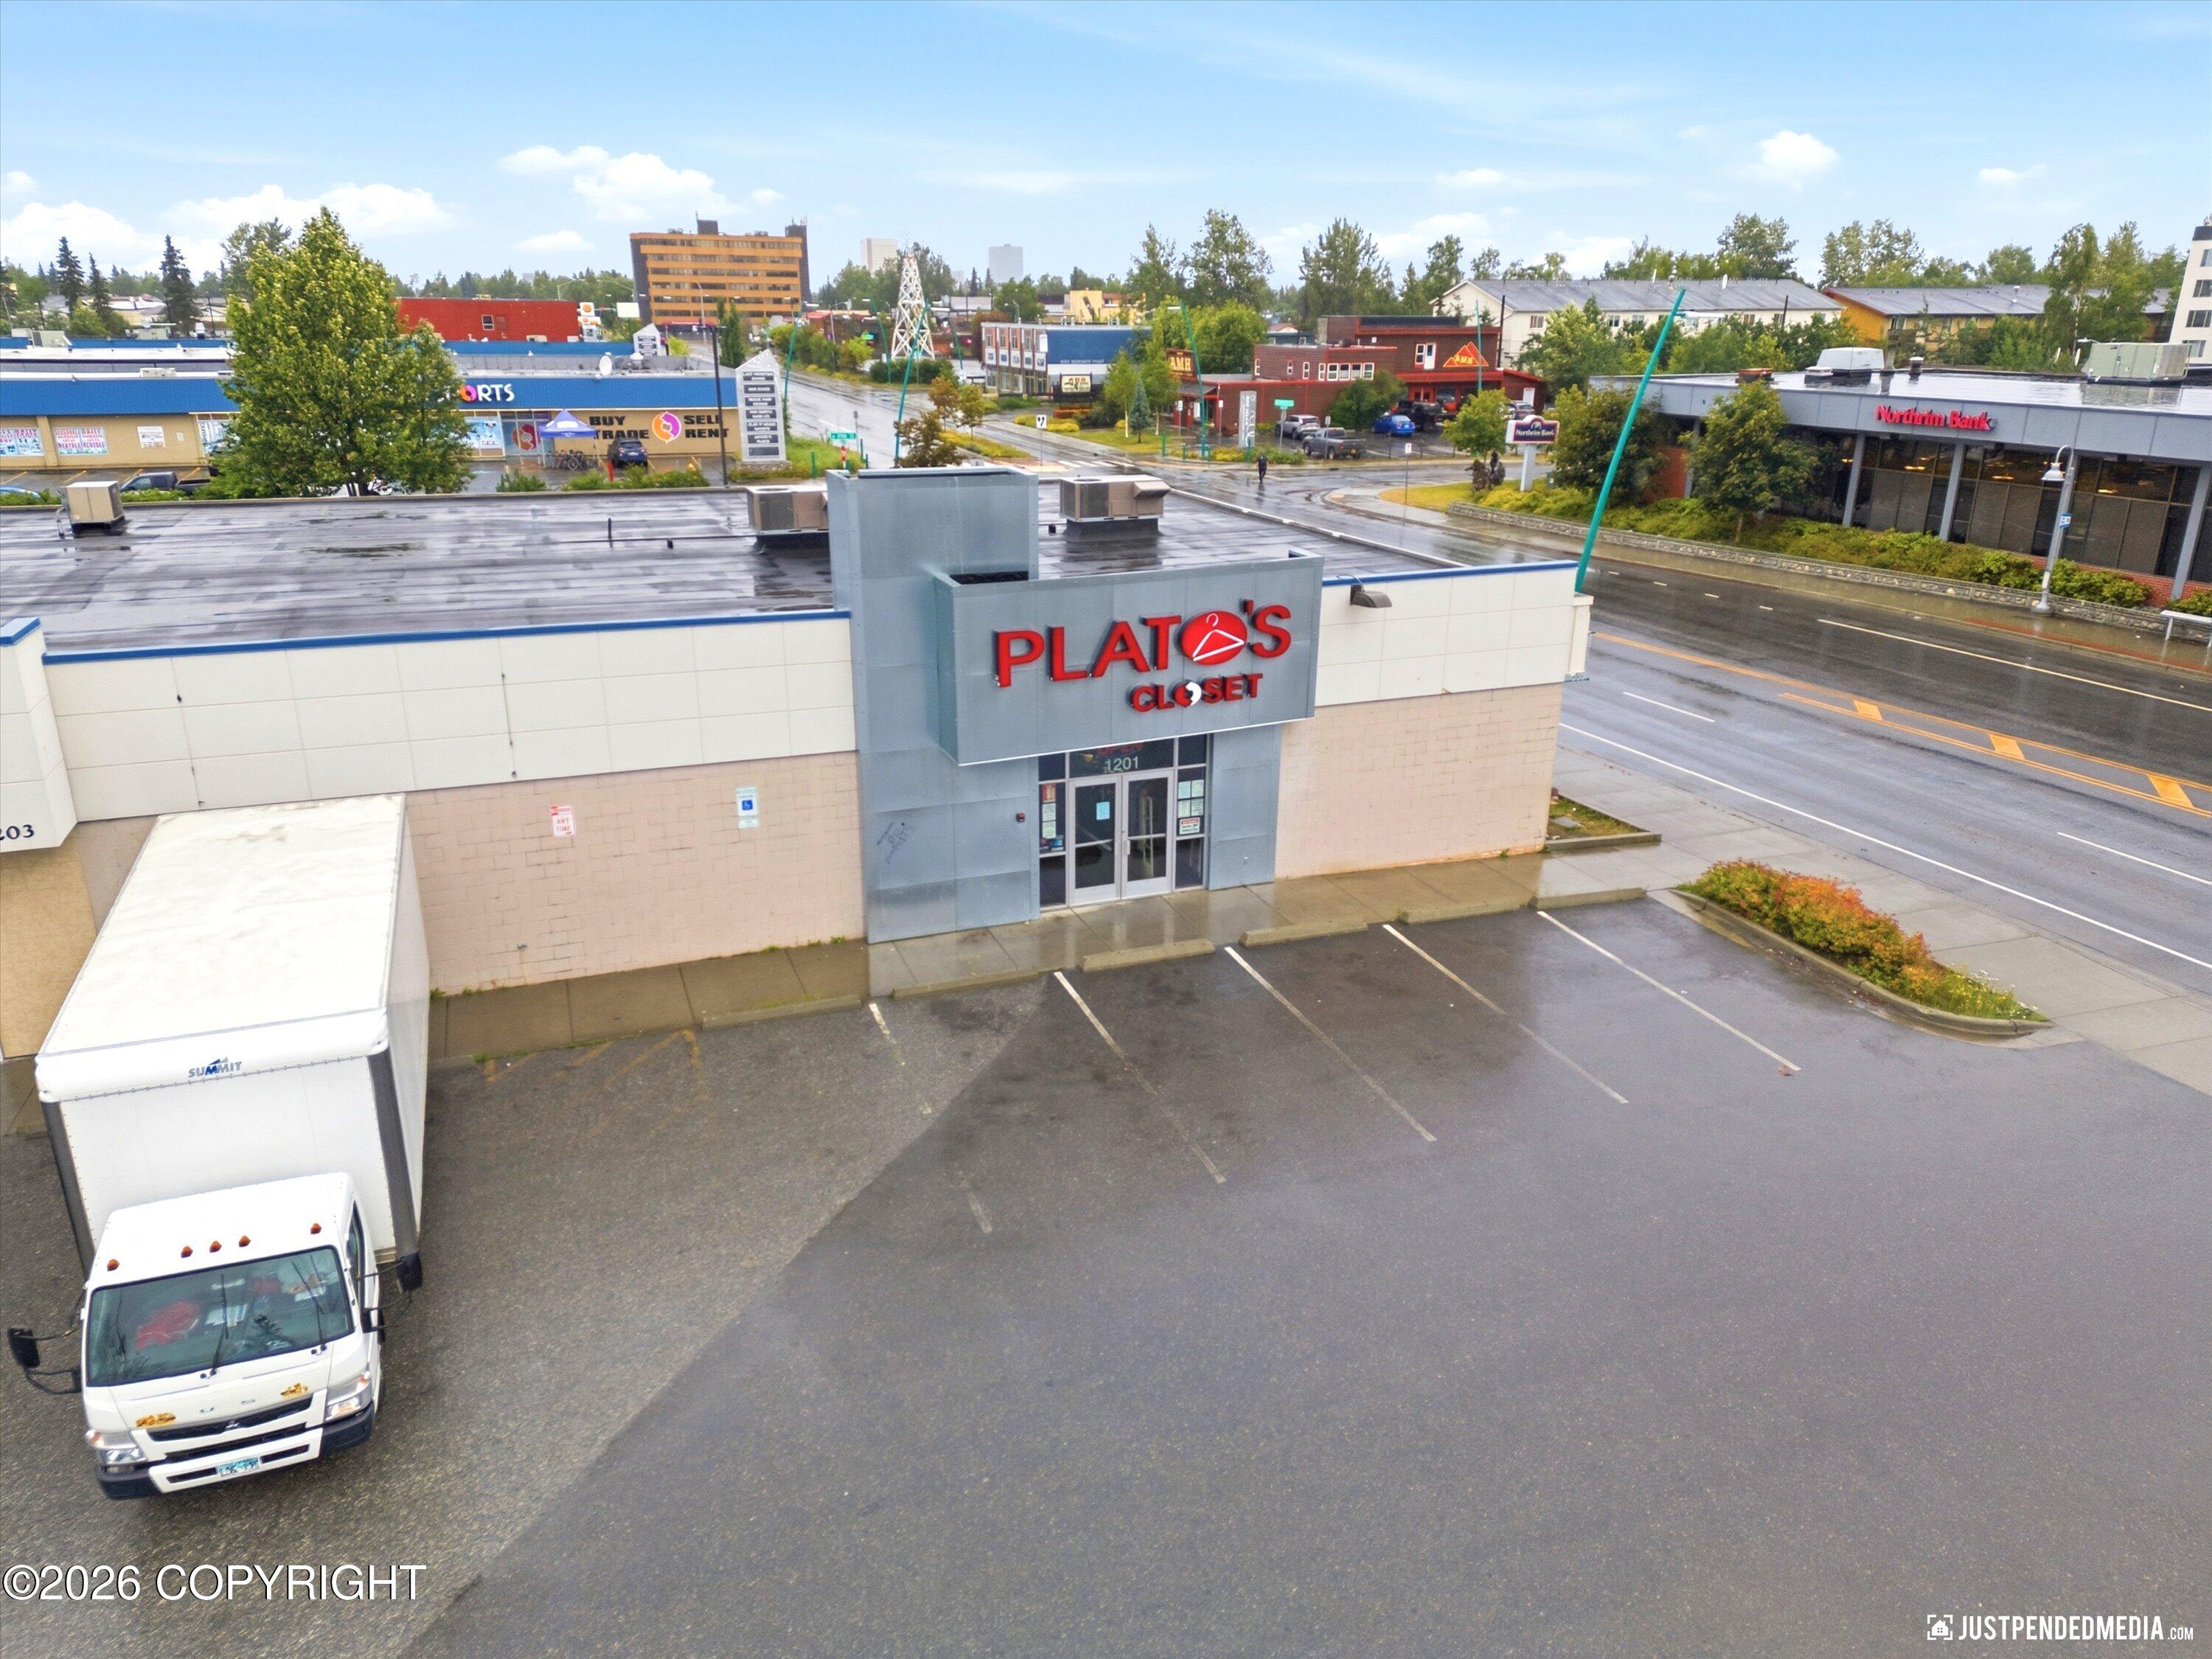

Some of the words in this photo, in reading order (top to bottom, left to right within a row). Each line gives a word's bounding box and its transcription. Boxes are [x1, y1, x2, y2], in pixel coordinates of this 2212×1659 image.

[459, 383, 515, 402] ORTS
[589, 416, 625, 425] BUY
[1876, 405, 1946, 428] Northrim
[1949, 409, 1990, 431] Bank
[994, 599, 1291, 687] PLATO'S
[1129, 673, 1263, 712] CLOSET
[1105, 757, 1138, 772] 1201
[188, 1061, 242, 1077] SUMMIT
